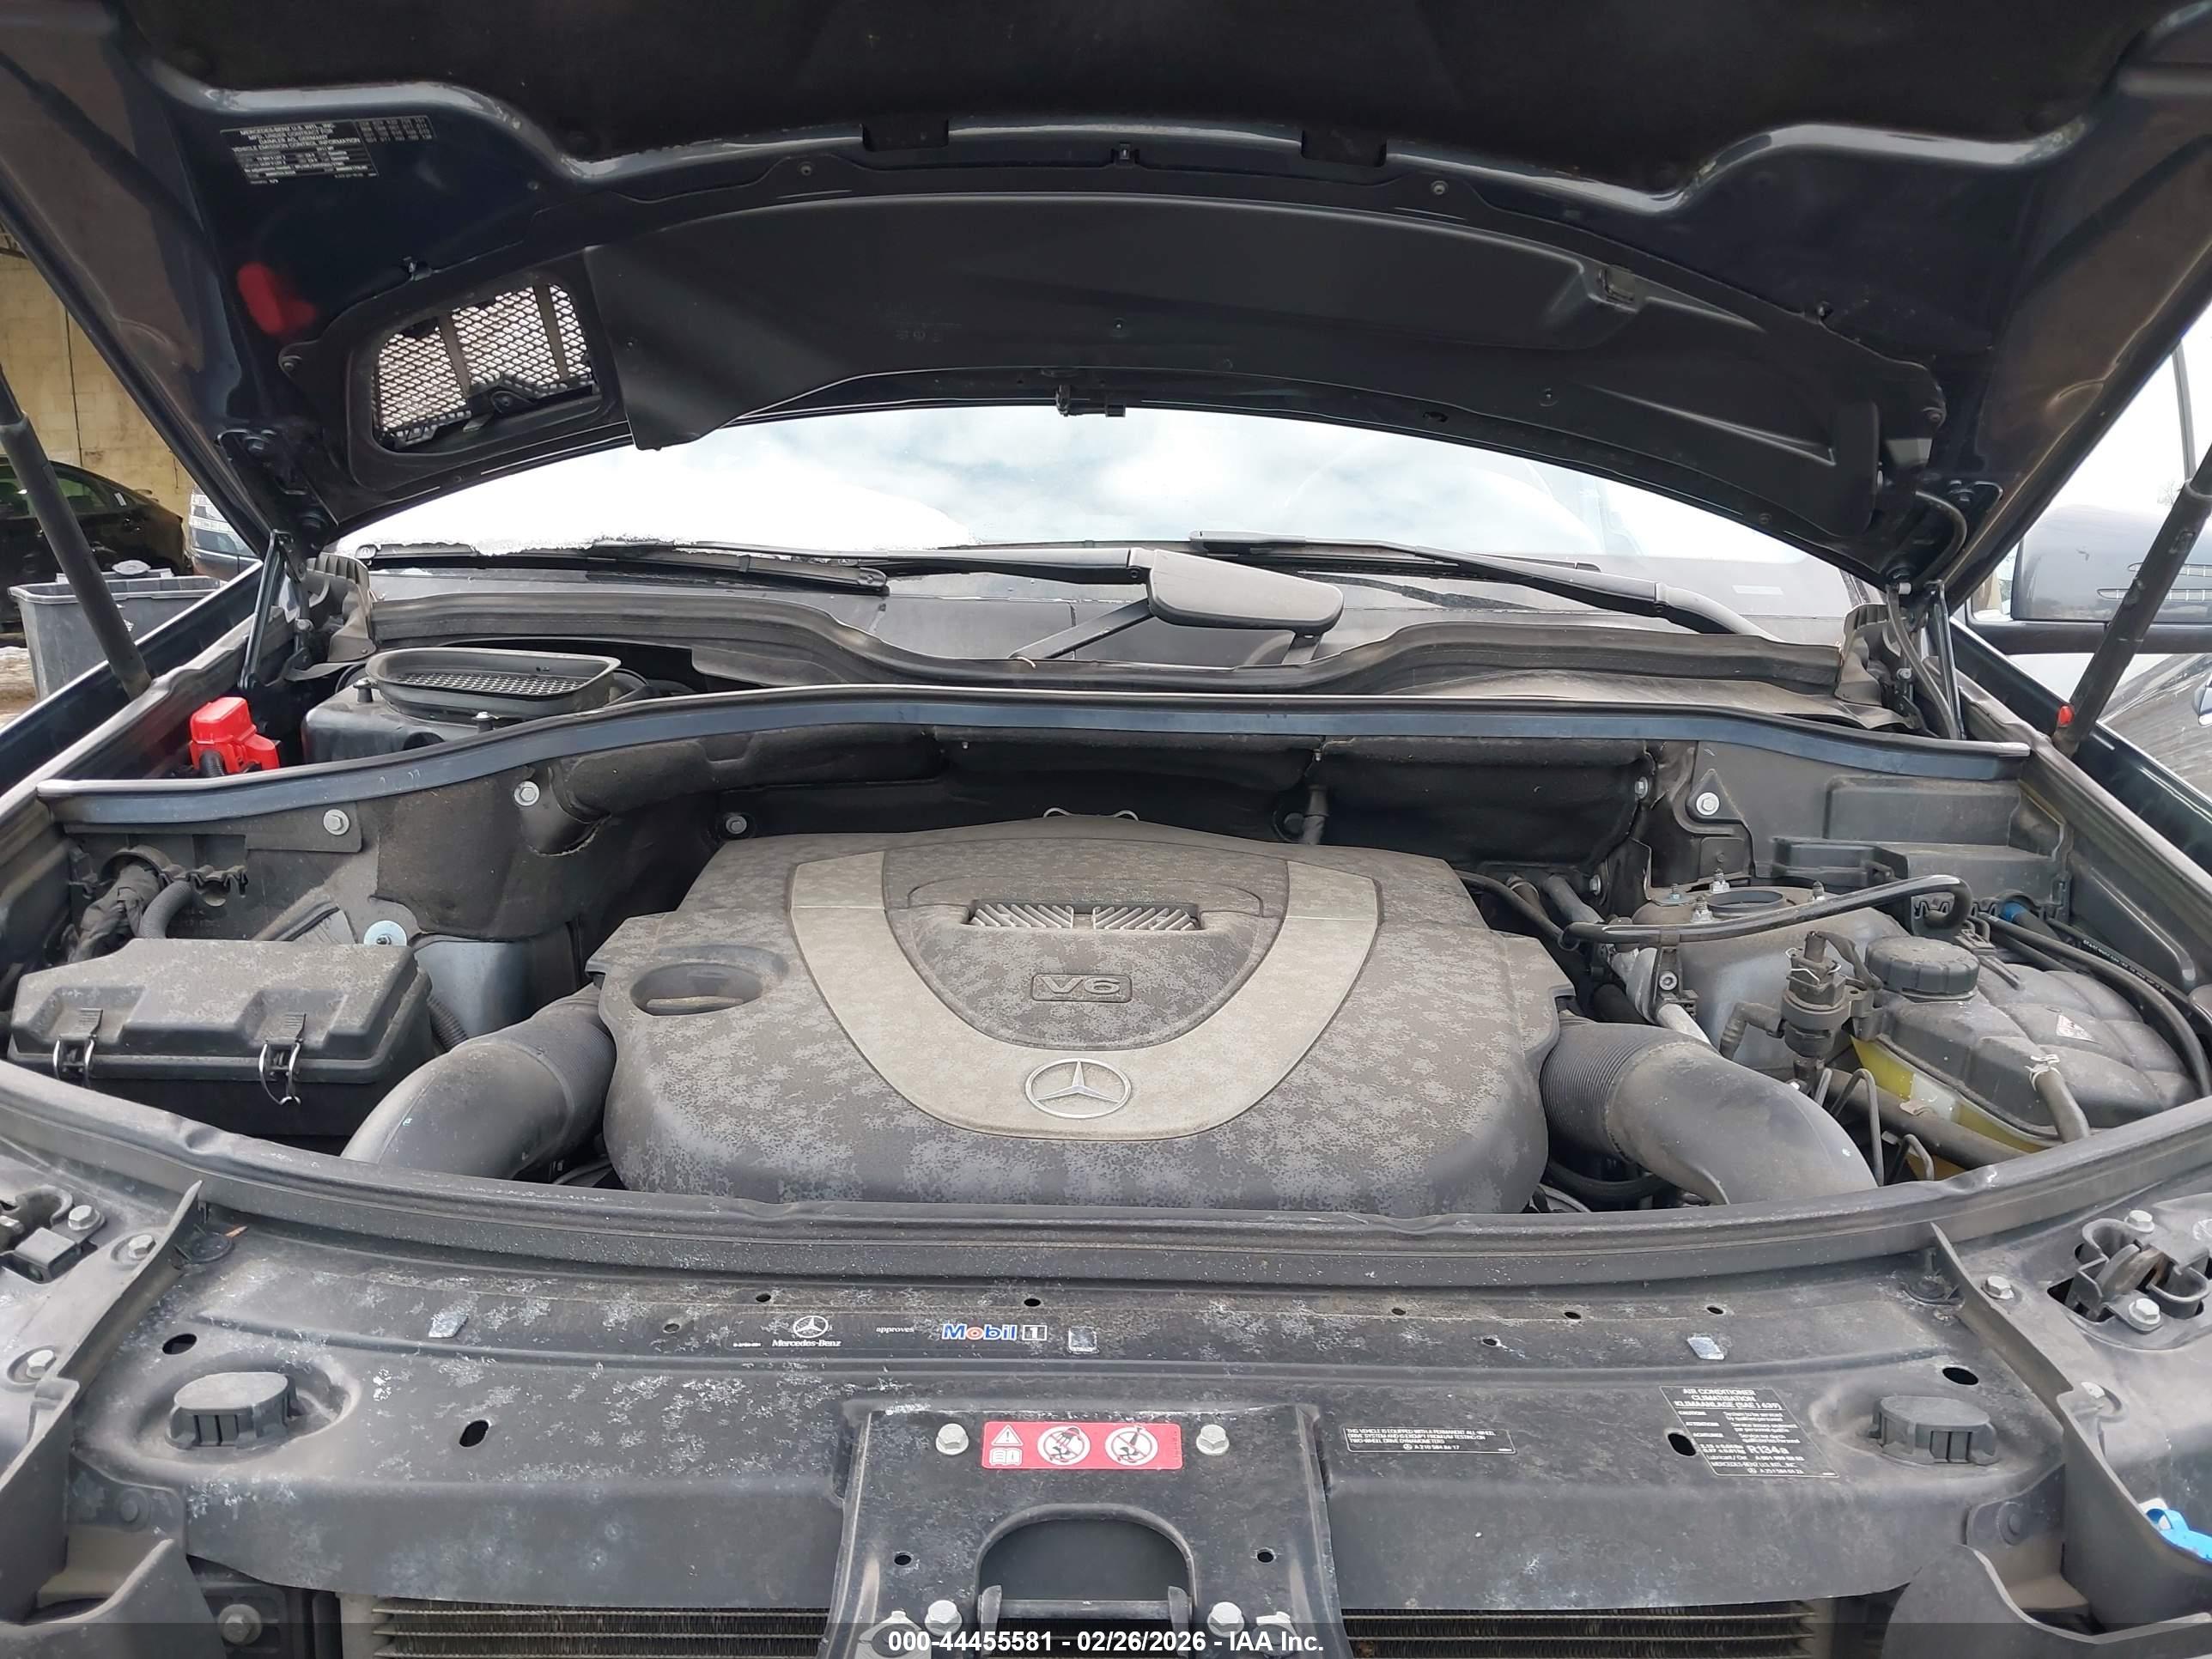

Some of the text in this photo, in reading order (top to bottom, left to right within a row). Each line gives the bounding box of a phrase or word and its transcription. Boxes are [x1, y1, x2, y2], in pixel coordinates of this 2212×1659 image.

[319, 137, 361, 146] INFORMATION
[1037, 976, 1121, 995] V6
[942, 1323, 1018, 1340] Mobil
[1747, 1445, 1790, 1455] R134a
